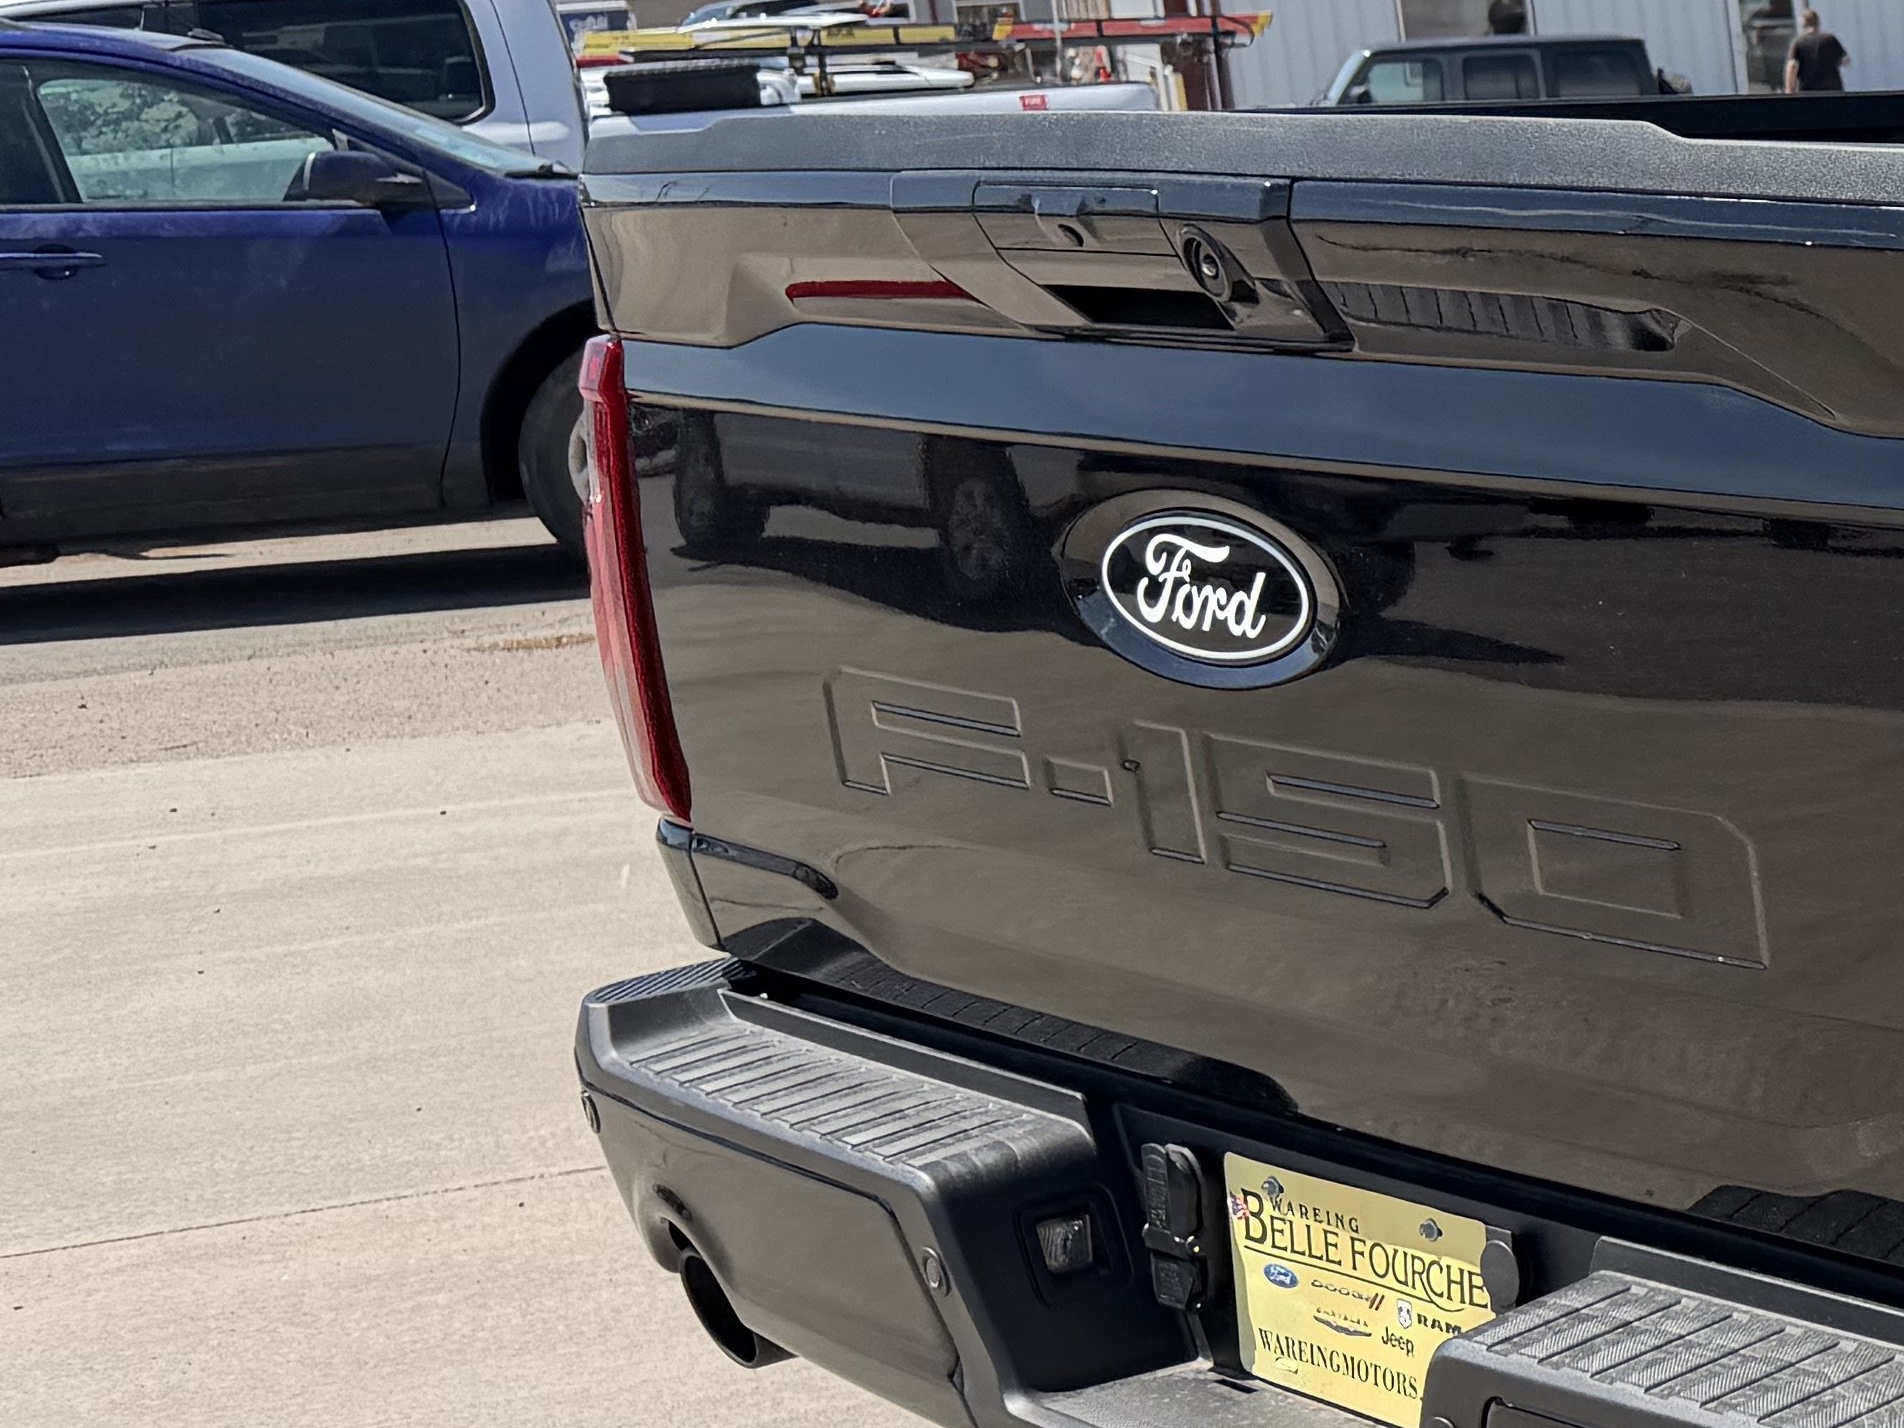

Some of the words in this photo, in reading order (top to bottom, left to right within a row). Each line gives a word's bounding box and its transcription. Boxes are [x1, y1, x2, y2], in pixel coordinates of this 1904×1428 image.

[1136, 532, 1267, 639] Ford
[823, 665, 1769, 970] F-150
[1240, 1187, 1342, 1267] BELLE
[1349, 1235, 1489, 1313] FOURCHE
[1269, 1196, 1360, 1234] WAREING
[1382, 1326, 1416, 1357] Jeep
[1417, 1313, 1462, 1335] RAM
